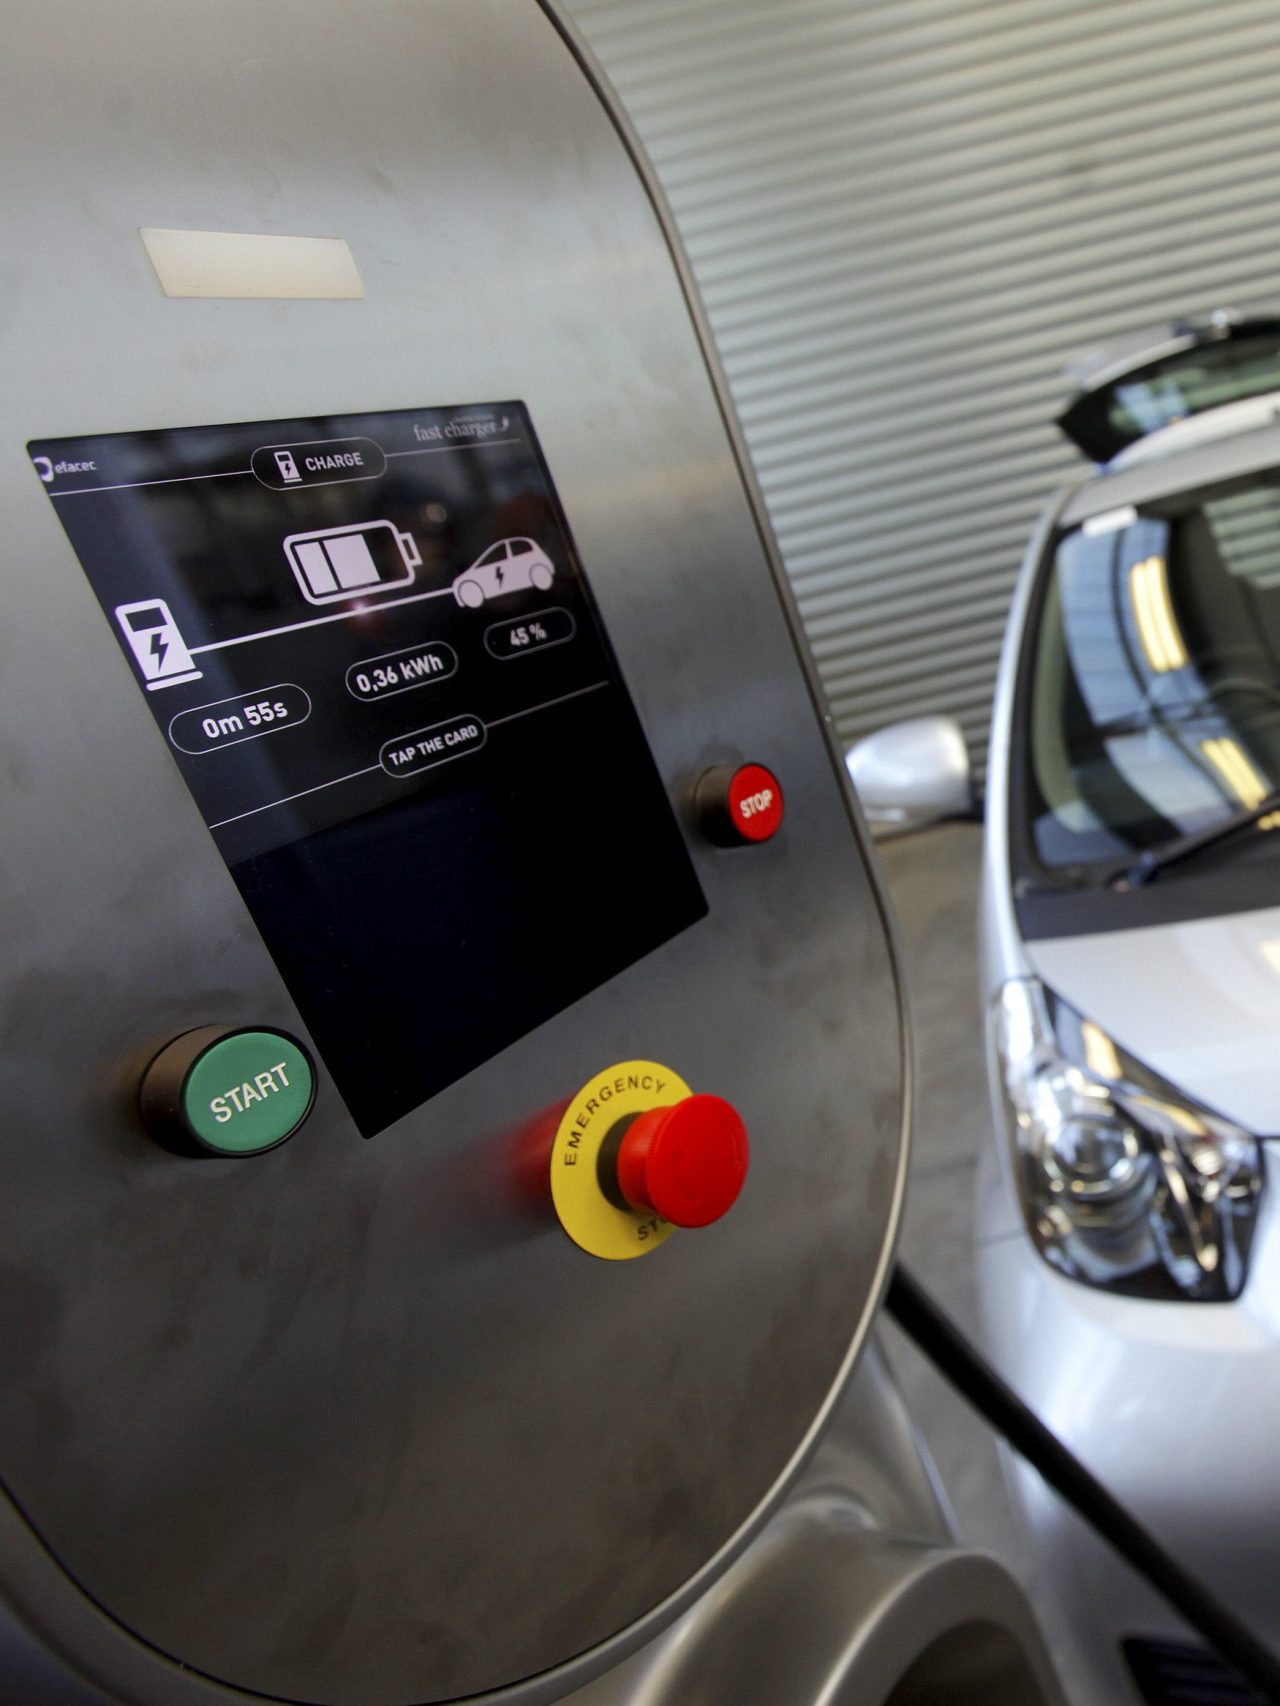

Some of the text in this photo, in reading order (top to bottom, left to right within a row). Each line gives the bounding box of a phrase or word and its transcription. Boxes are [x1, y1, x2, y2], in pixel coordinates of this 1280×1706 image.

[413, 420, 497, 441] fast charger
[54, 461, 97, 474] efacec
[305, 452, 364, 471] CHARGE
[510, 627, 530, 646] 45
[356, 654, 444, 693] 0,36 kWh
[202, 701, 288, 738] 0m 55s
[389, 724, 479, 766] TAP THE CARD
[740, 788, 773, 819] STOP
[210, 1061, 290, 1123] START
[564, 1075, 667, 1167] EMERGENCY
[637, 1218, 670, 1241] ST
